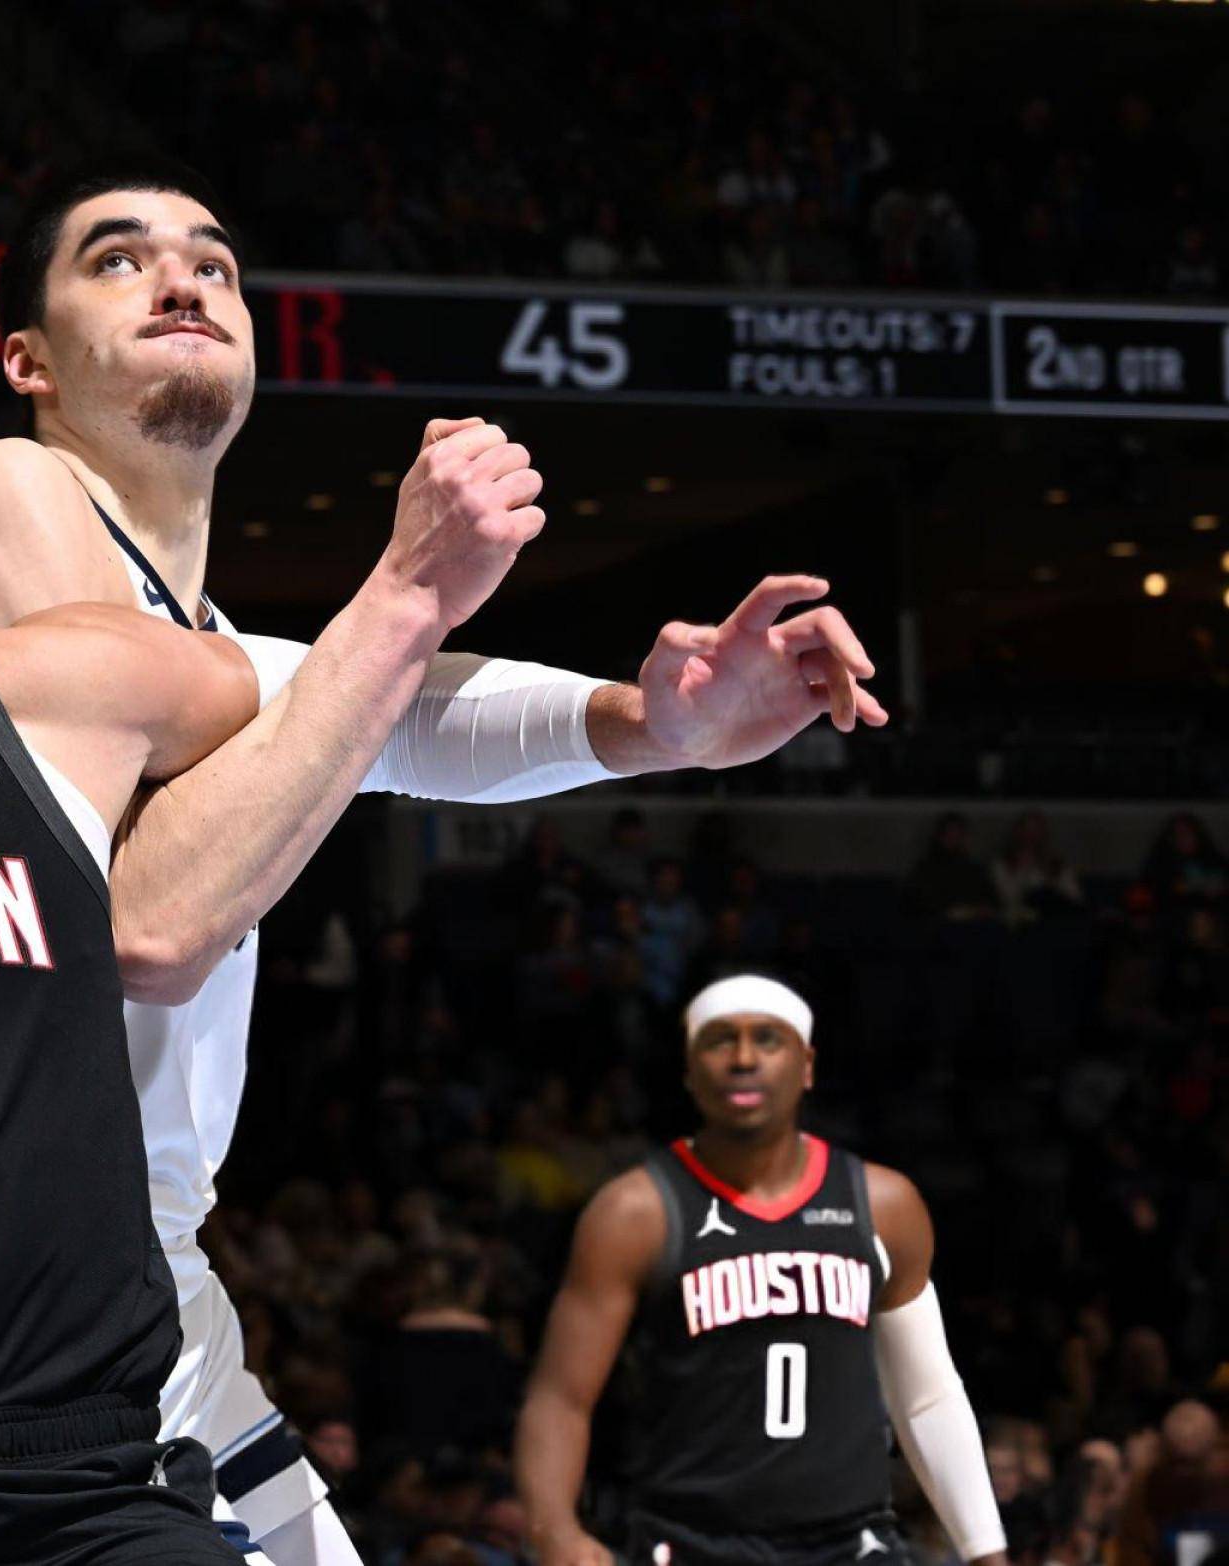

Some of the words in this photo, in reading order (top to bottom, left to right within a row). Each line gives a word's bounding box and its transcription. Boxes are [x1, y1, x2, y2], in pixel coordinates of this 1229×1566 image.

[501, 299, 629, 388] 45
[681, 1251, 871, 1338] HOUSTON
[765, 1342, 807, 1439] 0
